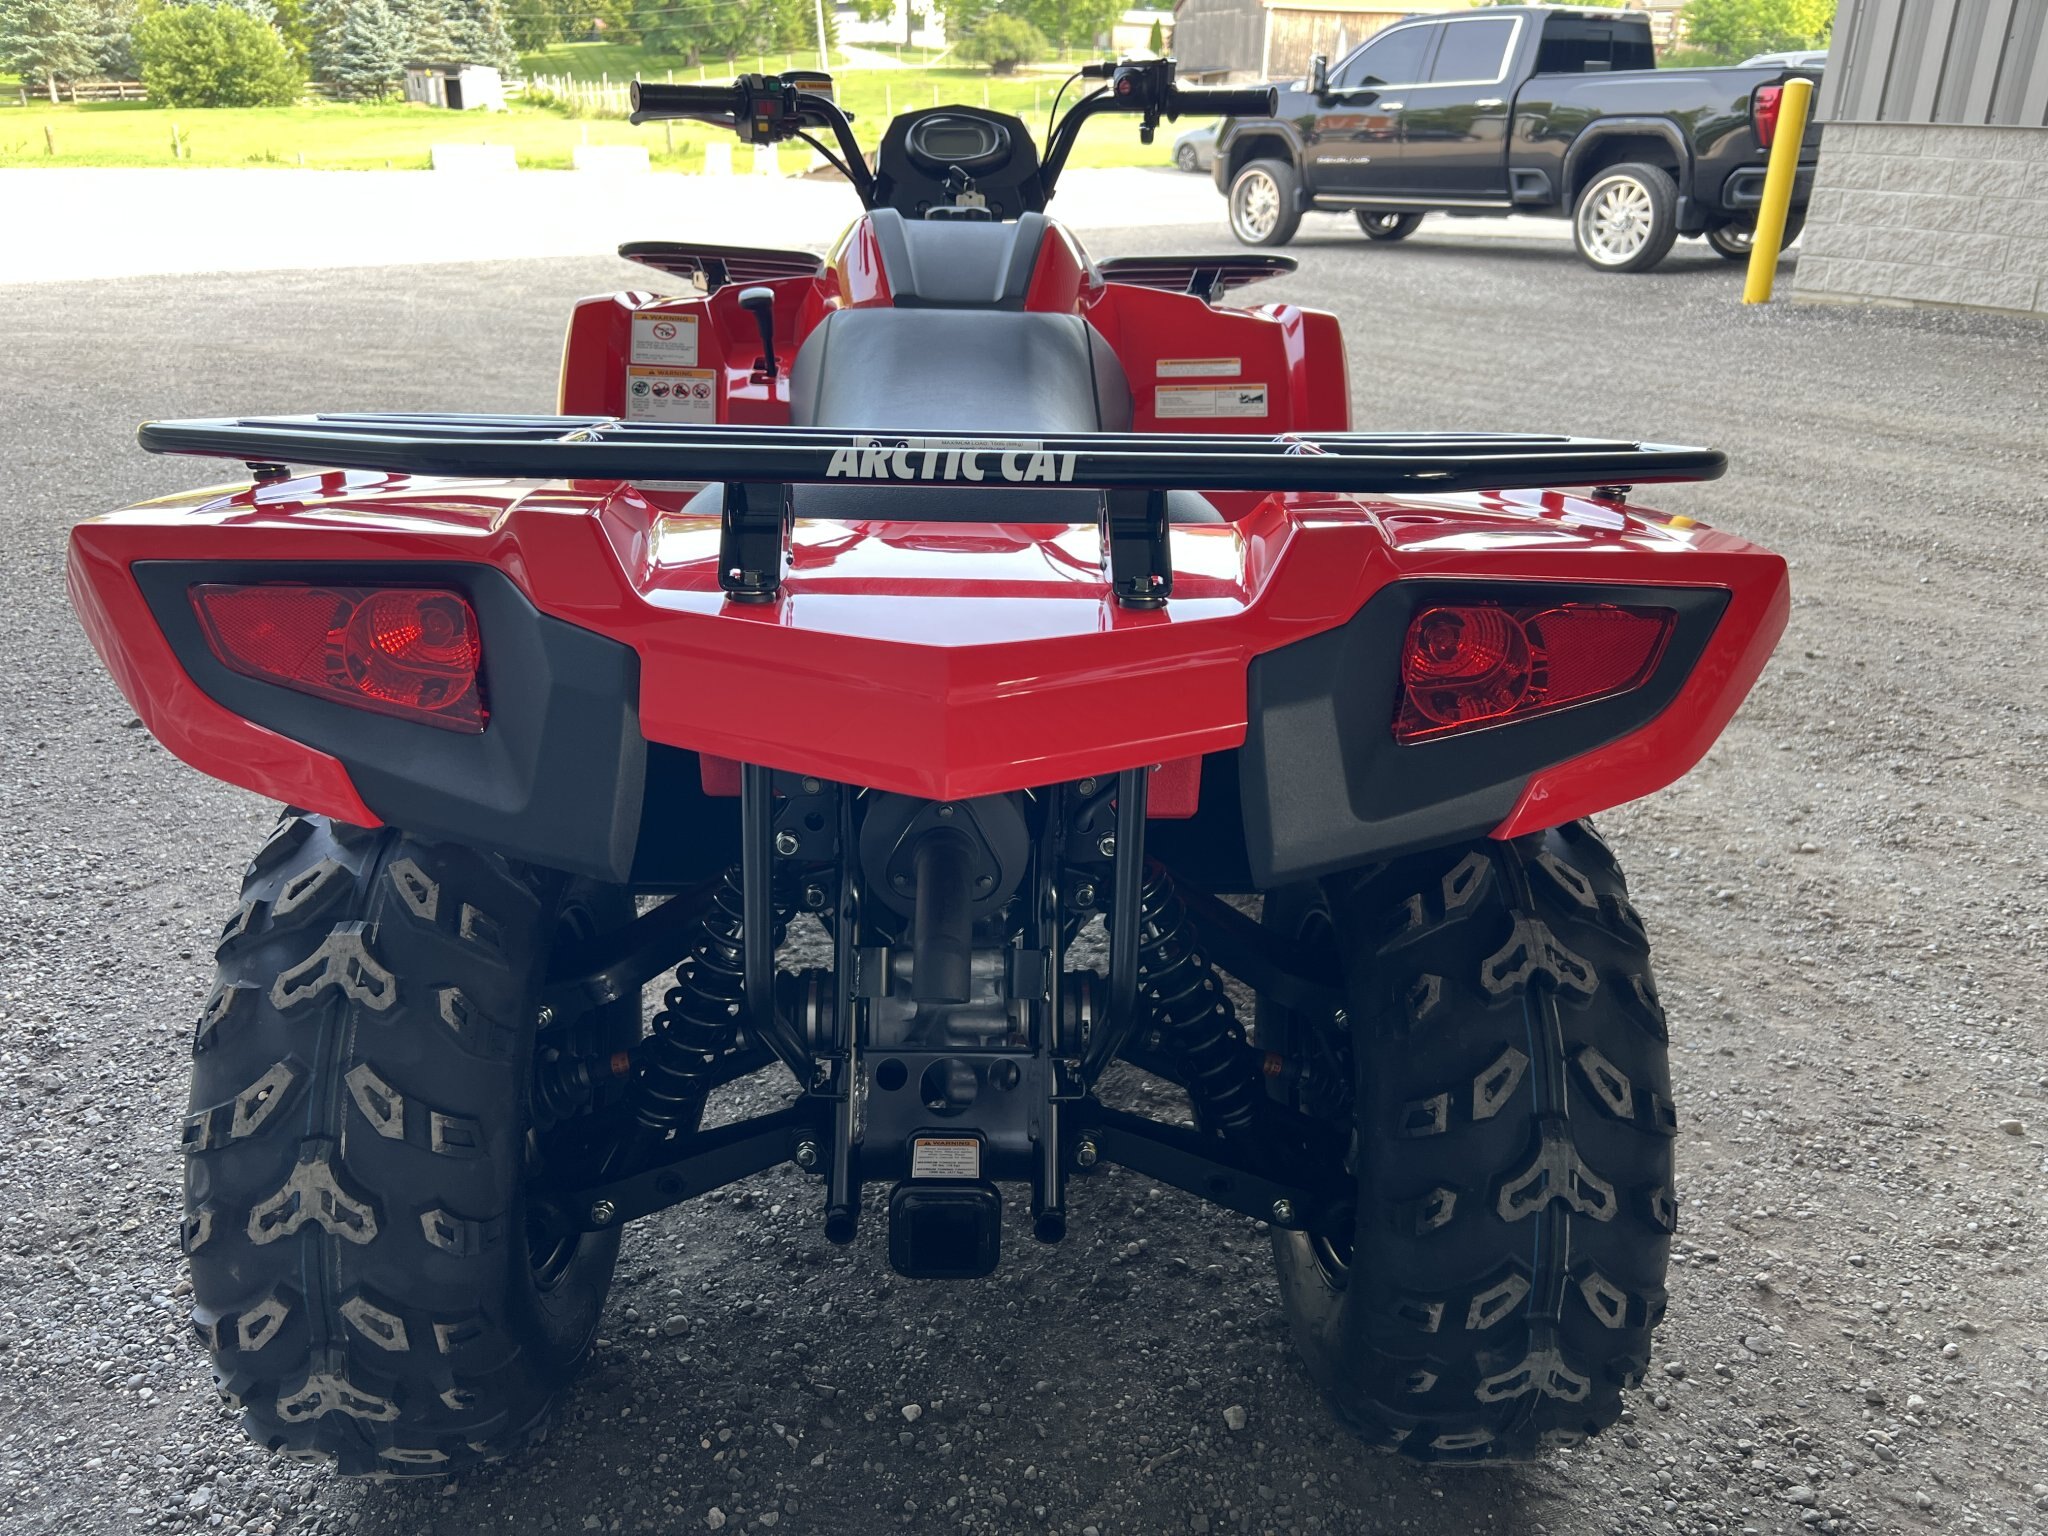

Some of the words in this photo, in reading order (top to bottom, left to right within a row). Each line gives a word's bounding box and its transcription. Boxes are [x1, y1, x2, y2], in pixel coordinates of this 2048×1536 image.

[649, 314, 689, 322] WARNING
[826, 449, 985, 480] ARCTIC
[1000, 451, 1077, 482] CAT
